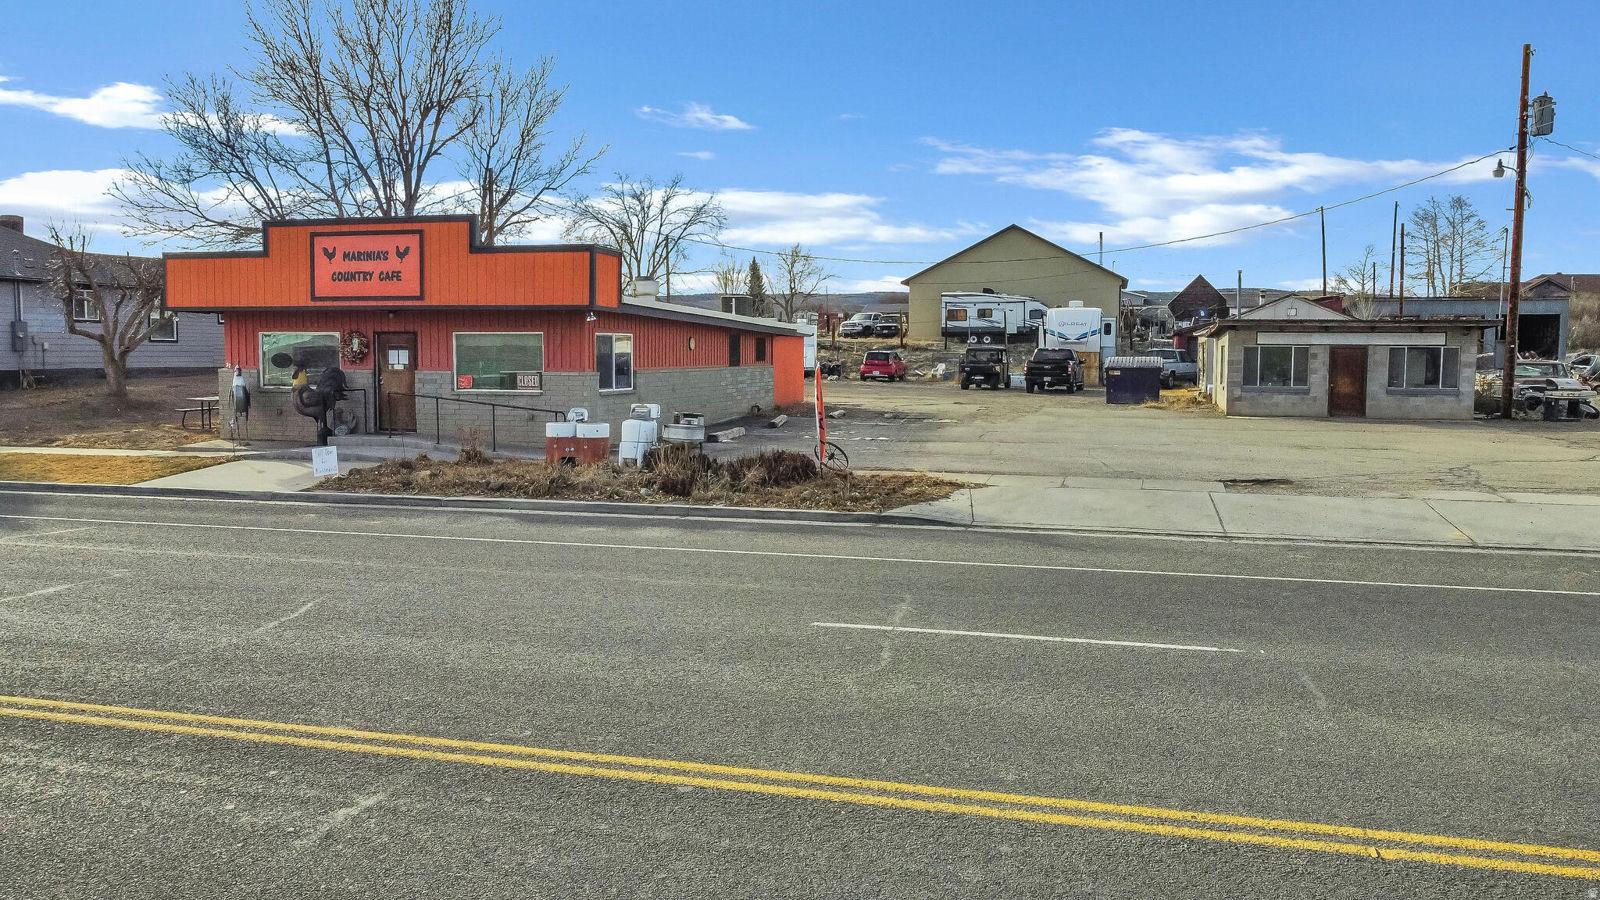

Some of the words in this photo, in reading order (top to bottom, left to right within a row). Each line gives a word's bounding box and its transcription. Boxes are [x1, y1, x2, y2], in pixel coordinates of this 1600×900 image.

[342, 250, 389, 262] MARINIA'S
[331, 271, 374, 282] COUNTRY
[378, 270, 402, 282] CAFE
[517, 375, 539, 387] CLOSED
